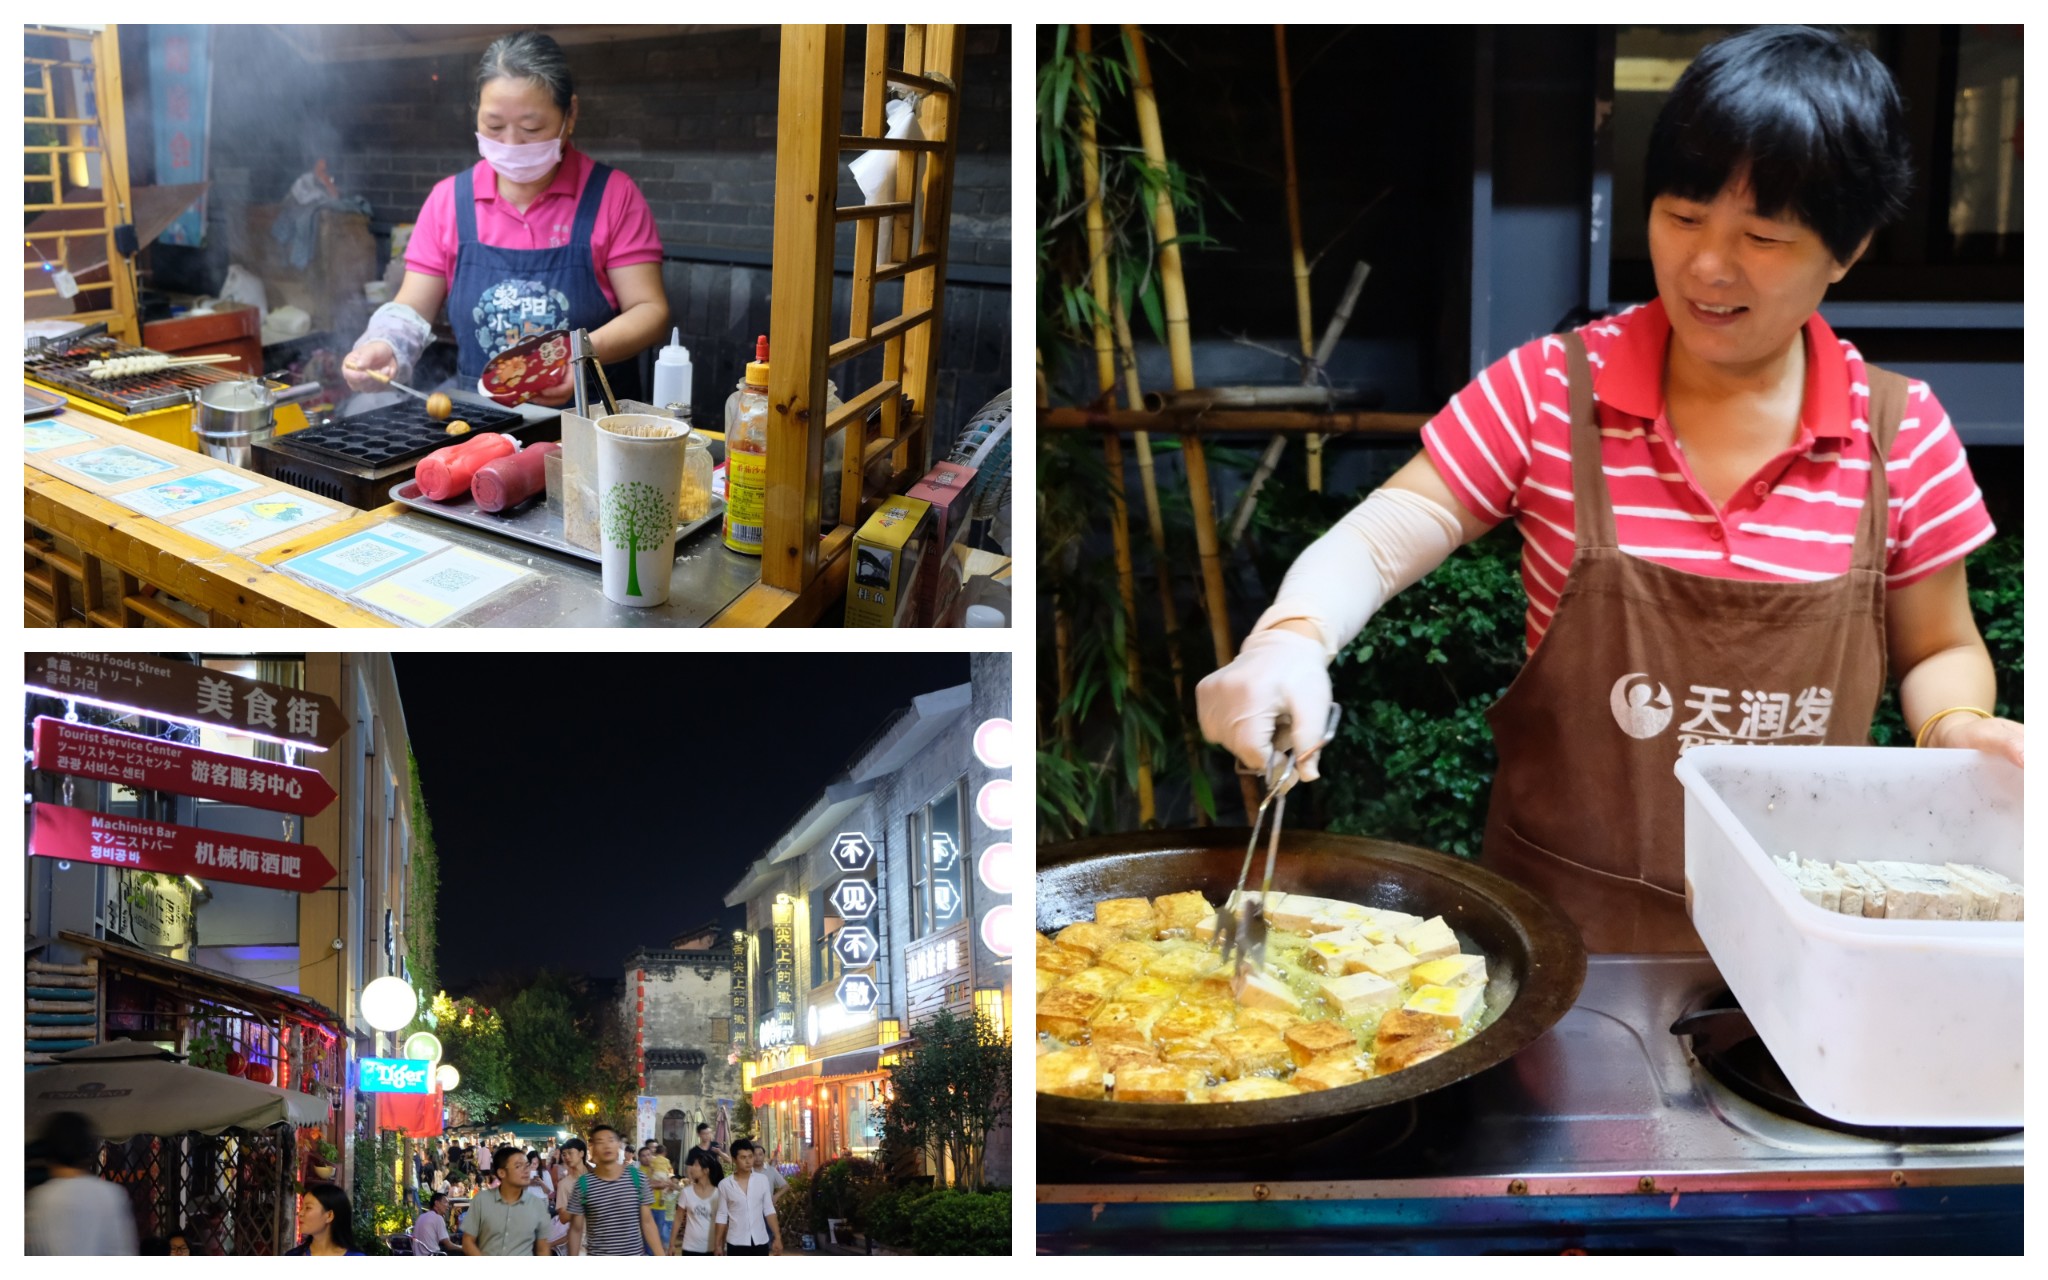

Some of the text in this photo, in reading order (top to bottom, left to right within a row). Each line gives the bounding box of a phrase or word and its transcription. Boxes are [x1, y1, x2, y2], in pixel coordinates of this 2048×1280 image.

[493, 285, 547, 319] 黎阳
[103, 654, 136, 670] Foods
[138, 661, 172, 678] Street
[74, 677, 98, 693] 거리
[197, 675, 320, 738] 美食街
[1678, 684, 1834, 739] 天润发
[58, 726, 182, 758] Tourist Service Center
[58, 741, 181, 770] ツーリストサービスセンター
[57, 755, 145, 781] 관광 서비스 센터
[191, 759, 303, 800] 游客服务中心
[91, 816, 177, 839] Machinist Bar
[91, 831, 173, 851] マシニストバー
[128, 851, 141, 864] 바
[194, 841, 301, 879] 机械师酒吧
[378, 1064, 426, 1089] Tiger
